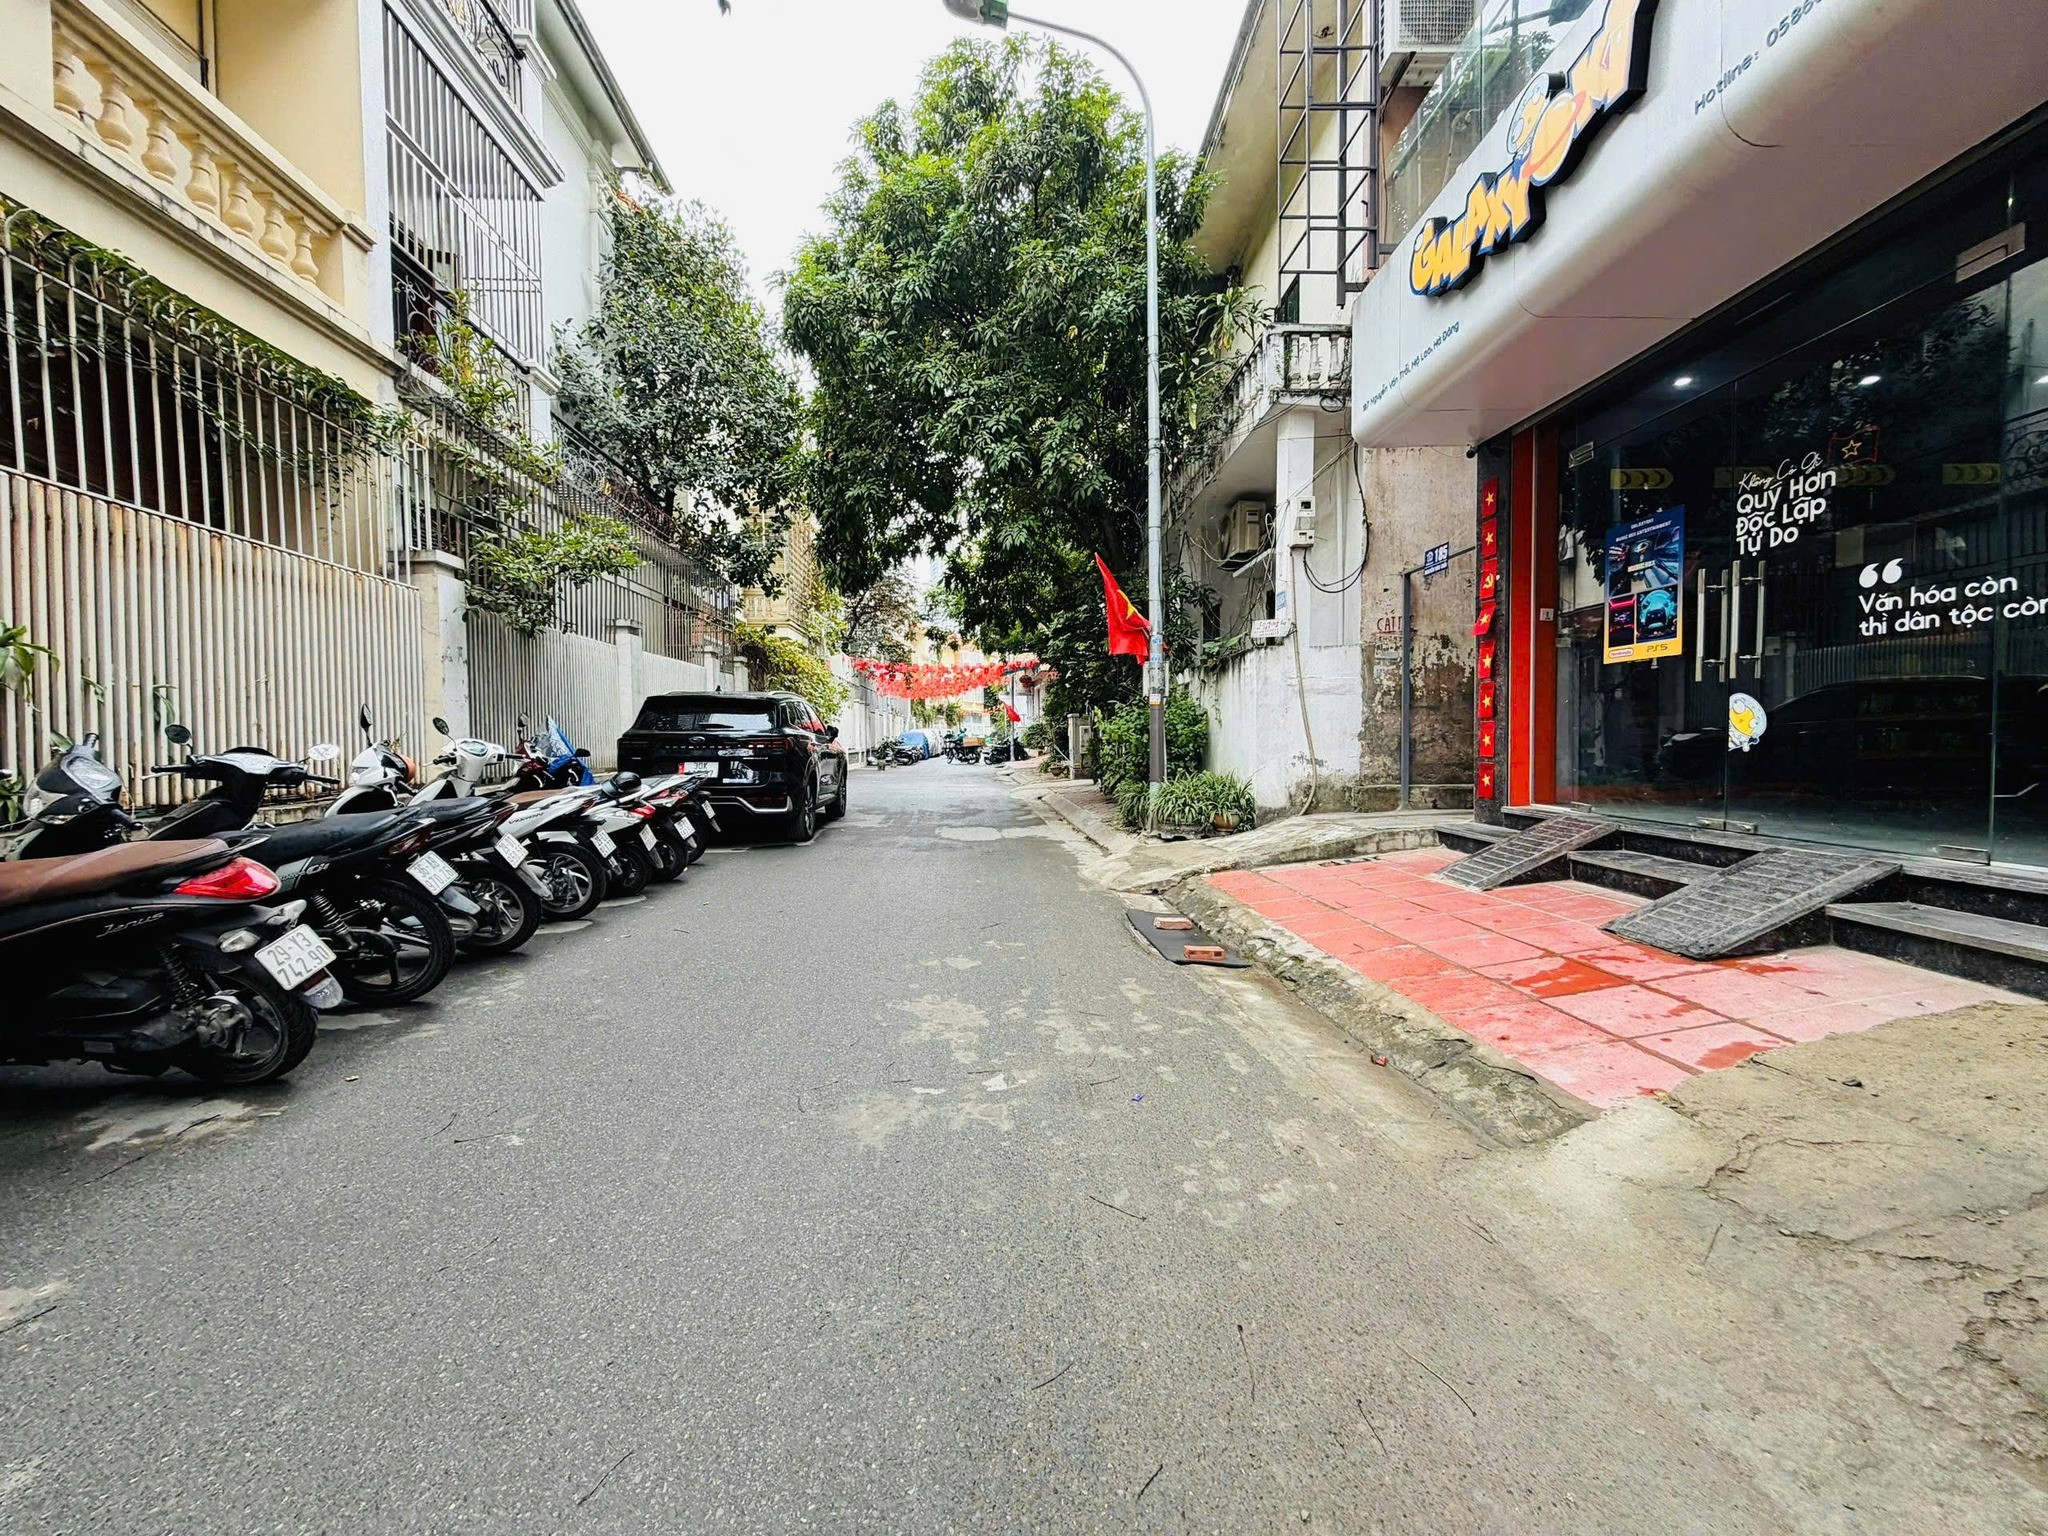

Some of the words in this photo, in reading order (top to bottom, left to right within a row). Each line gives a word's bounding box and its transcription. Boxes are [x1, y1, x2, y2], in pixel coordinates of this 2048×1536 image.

[1694, 51, 1759, 115] Hotline:
[1766, 0, 1822, 47] 0586
[1777, 459, 1798, 480] Có
[1736, 481, 1782, 513] Quý
[1789, 470, 1836, 499] Hơn
[1736, 511, 1776, 537] Độc
[1782, 496, 1826, 525] Lập
[1736, 530, 1763, 556] Tự
[1769, 527, 1799, 548] Do
[1858, 592, 1903, 614] Văn
[1910, 585, 1957, 607] hóa
[1964, 576, 2018, 598] còn
[1859, 613, 1888, 637] thì
[1894, 611, 1940, 632] dân
[1949, 603, 1994, 629] tộc
[1646, 643, 1668, 652] PS5
[425, 866, 454, 891] 970.26
[96, 912, 165, 938] Janus
[267, 932, 312, 966] 29-Y3
[277, 945, 329, 986] 742.90
